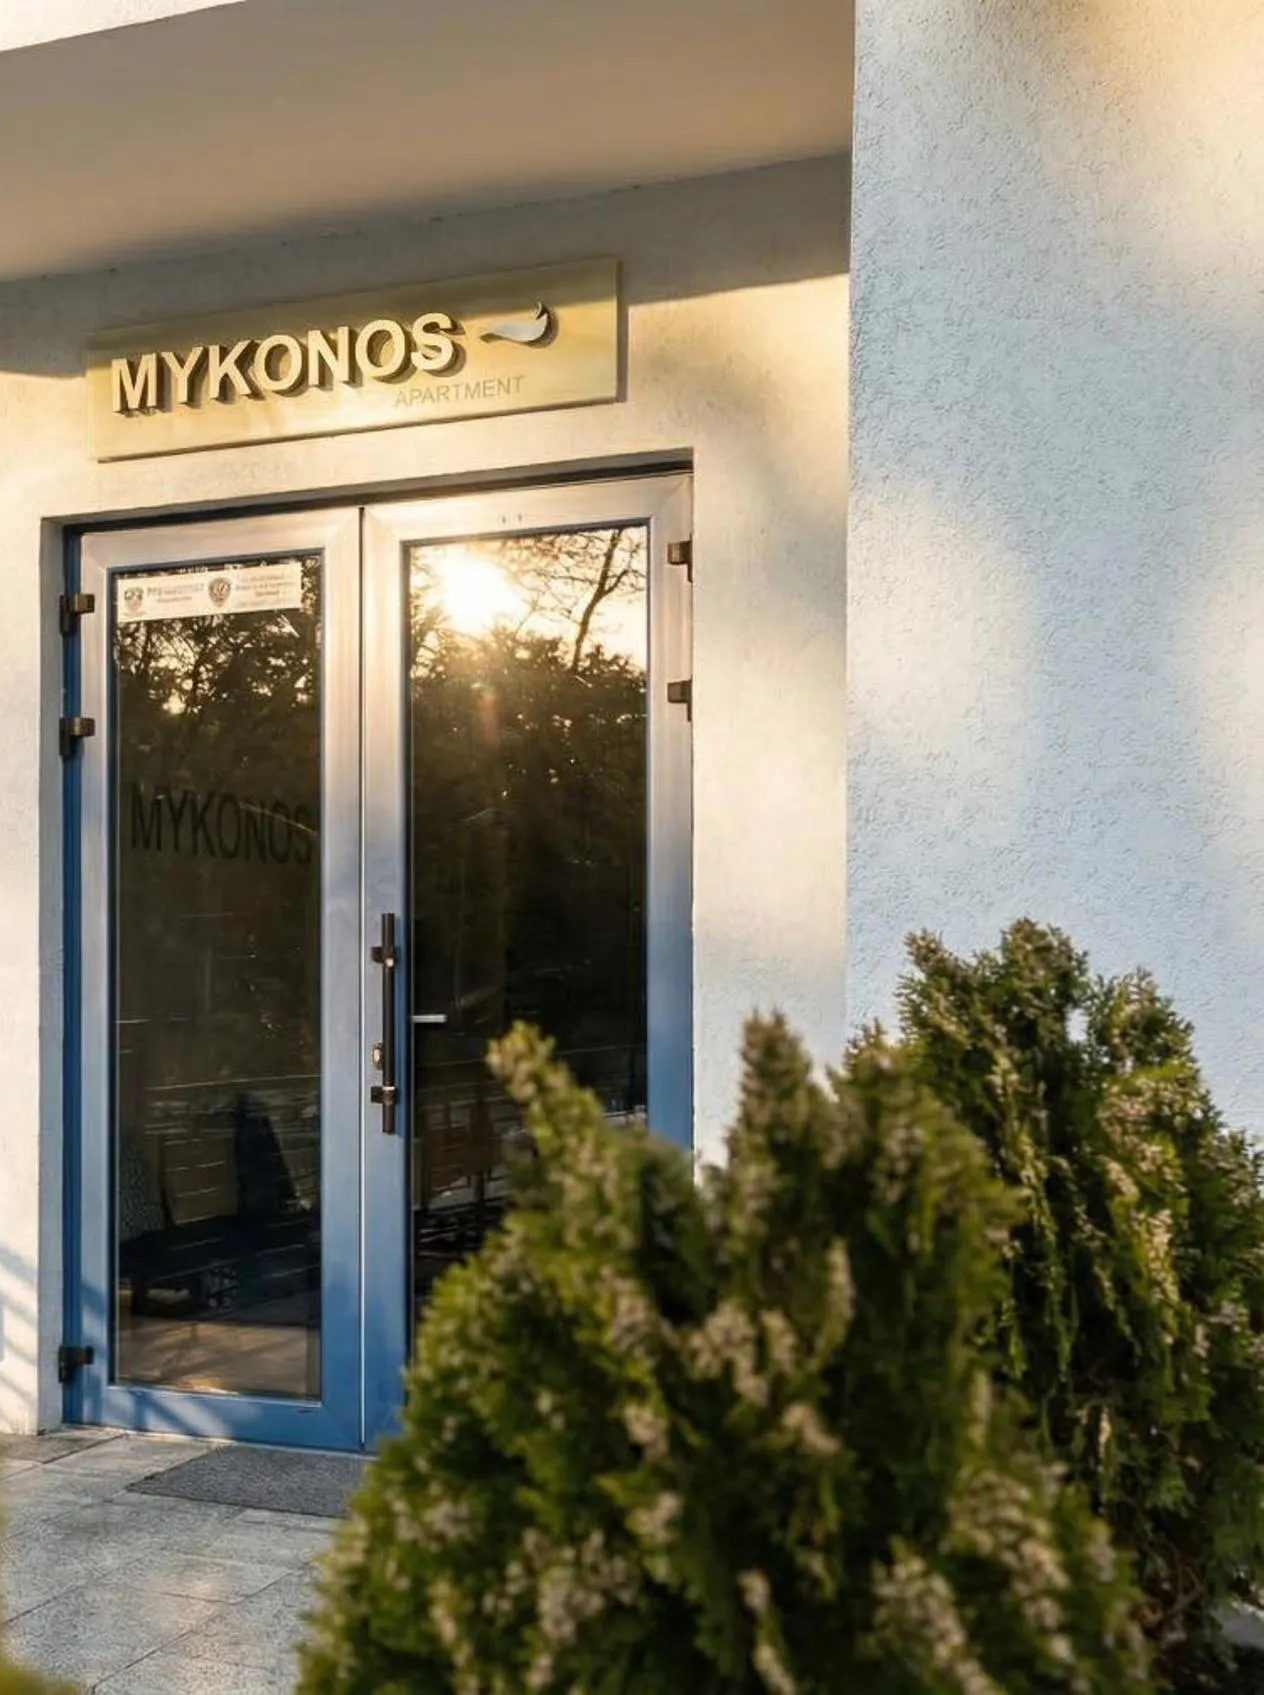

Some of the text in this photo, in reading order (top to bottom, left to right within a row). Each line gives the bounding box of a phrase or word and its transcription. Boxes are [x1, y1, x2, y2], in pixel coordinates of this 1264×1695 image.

[111, 312, 458, 413] MYKONOS
[395, 375, 525, 407] APARTMENT
[131, 784, 312, 865] MYKONOS
